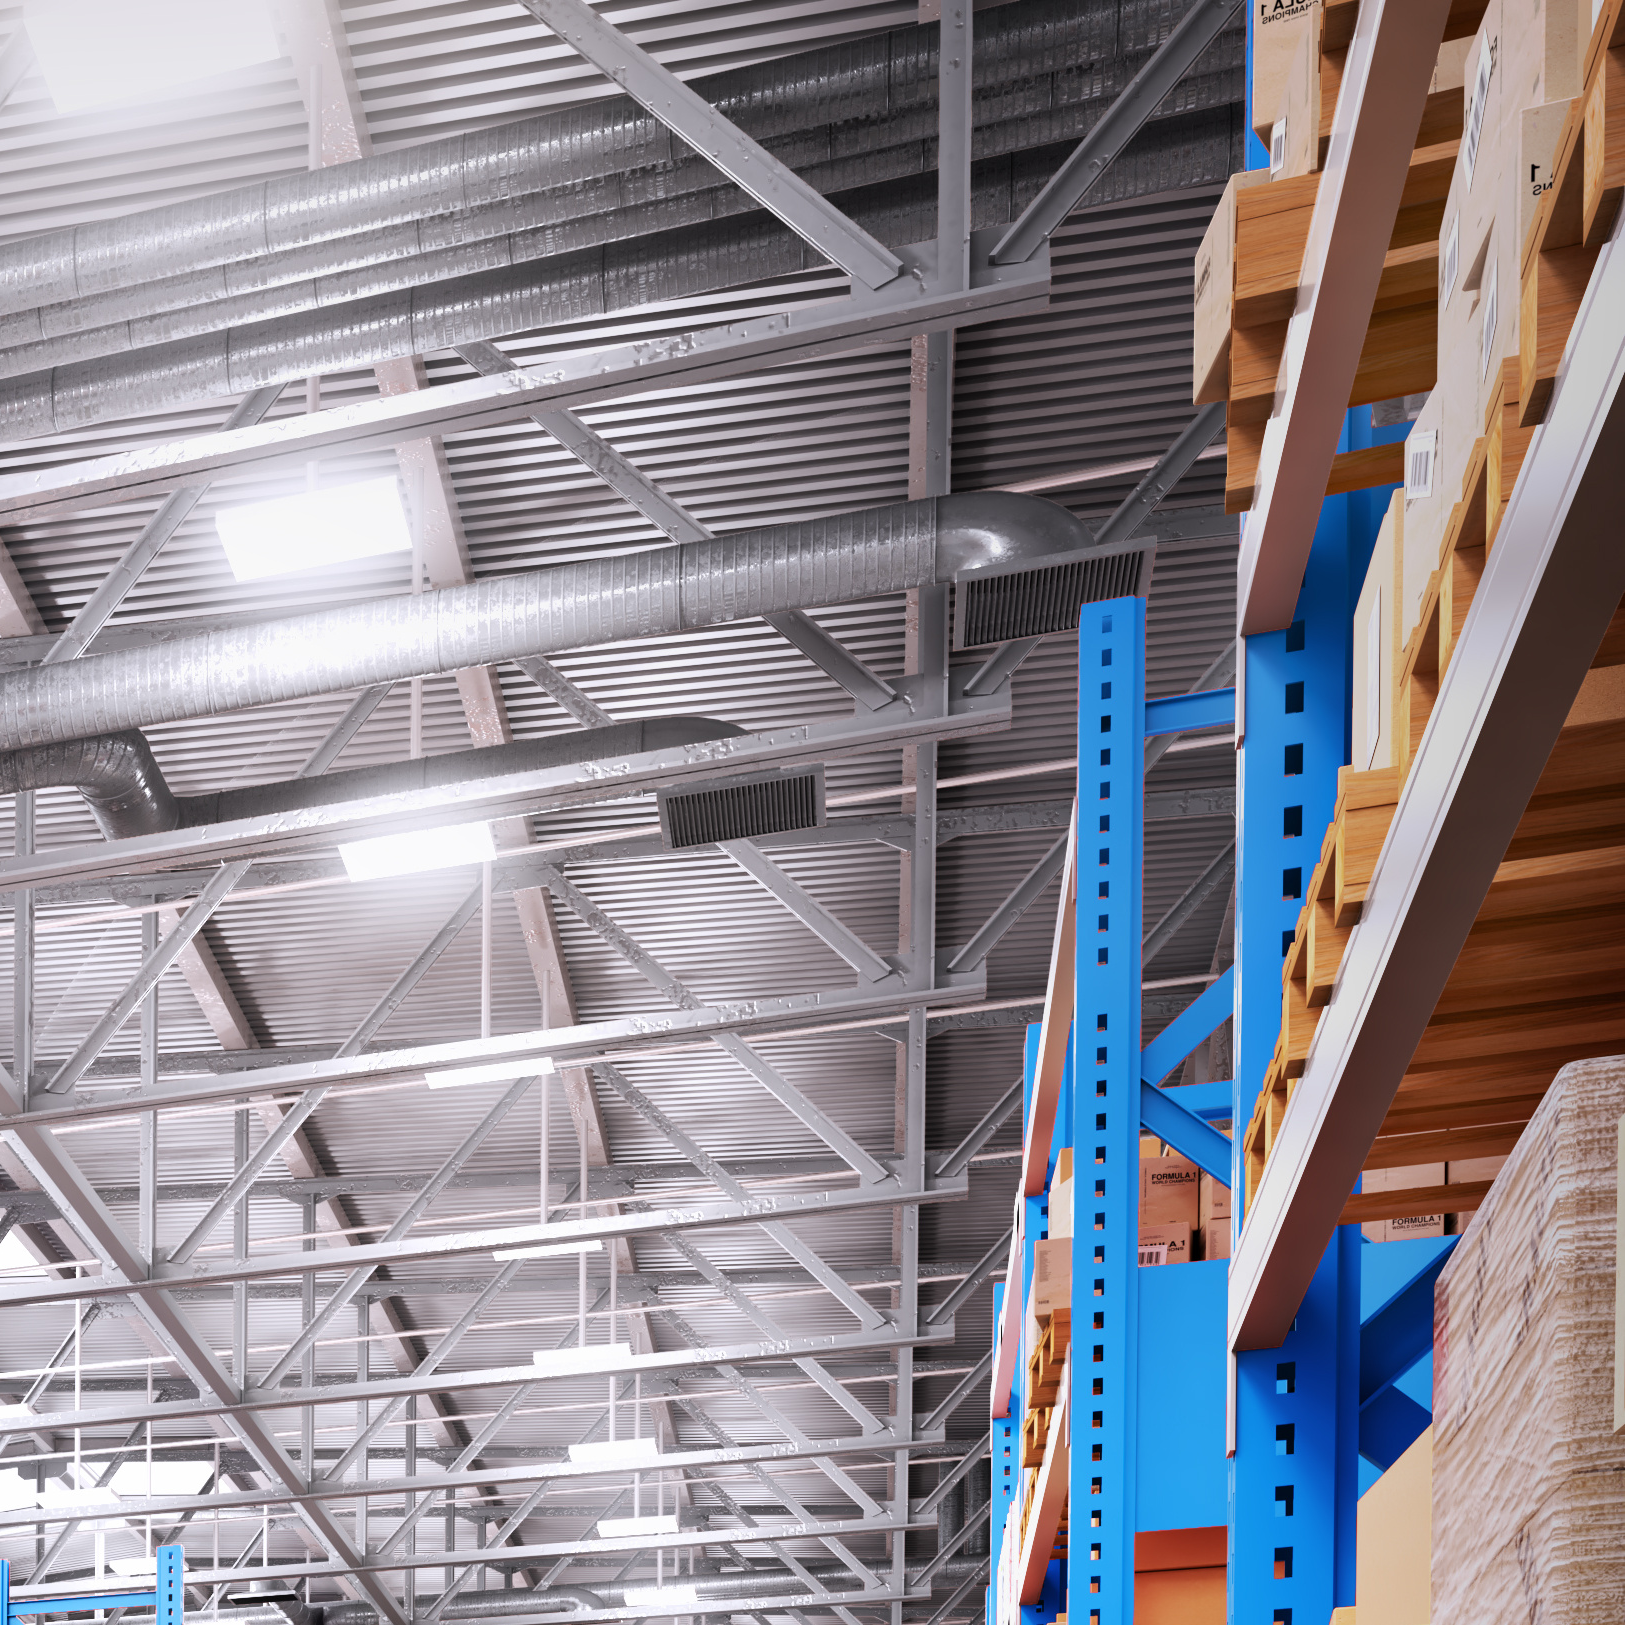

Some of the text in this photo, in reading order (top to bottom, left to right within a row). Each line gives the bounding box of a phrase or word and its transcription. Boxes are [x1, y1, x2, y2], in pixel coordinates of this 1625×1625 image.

[1151, 1171, 1196, 1181] FORMULA 1
[1392, 1215, 1441, 1226] FORMULA 1
